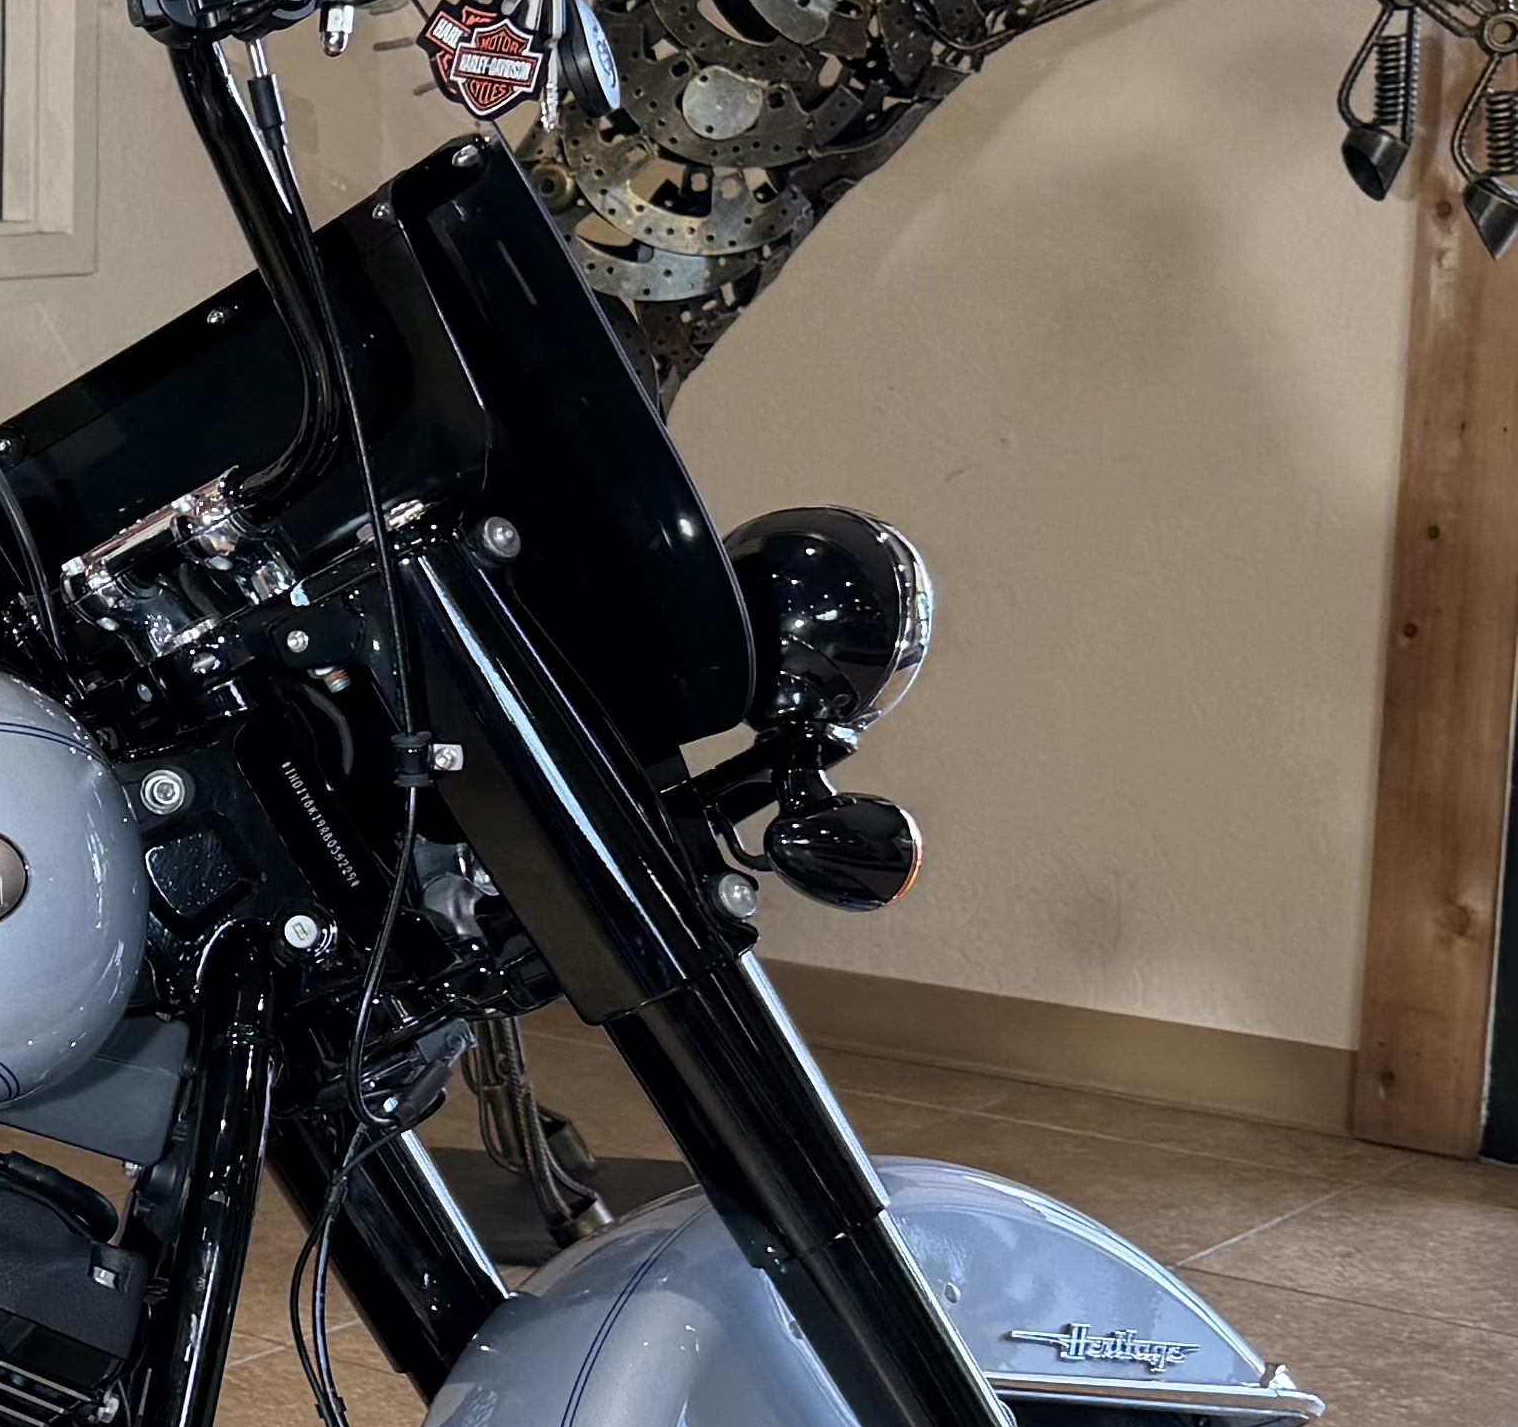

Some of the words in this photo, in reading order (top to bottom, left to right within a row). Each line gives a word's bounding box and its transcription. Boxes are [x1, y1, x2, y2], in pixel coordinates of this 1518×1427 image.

[481, 31, 520, 54] MOTOR
[470, 79, 507, 105] CYCLES
[1058, 1323, 1187, 1372] Heritage
